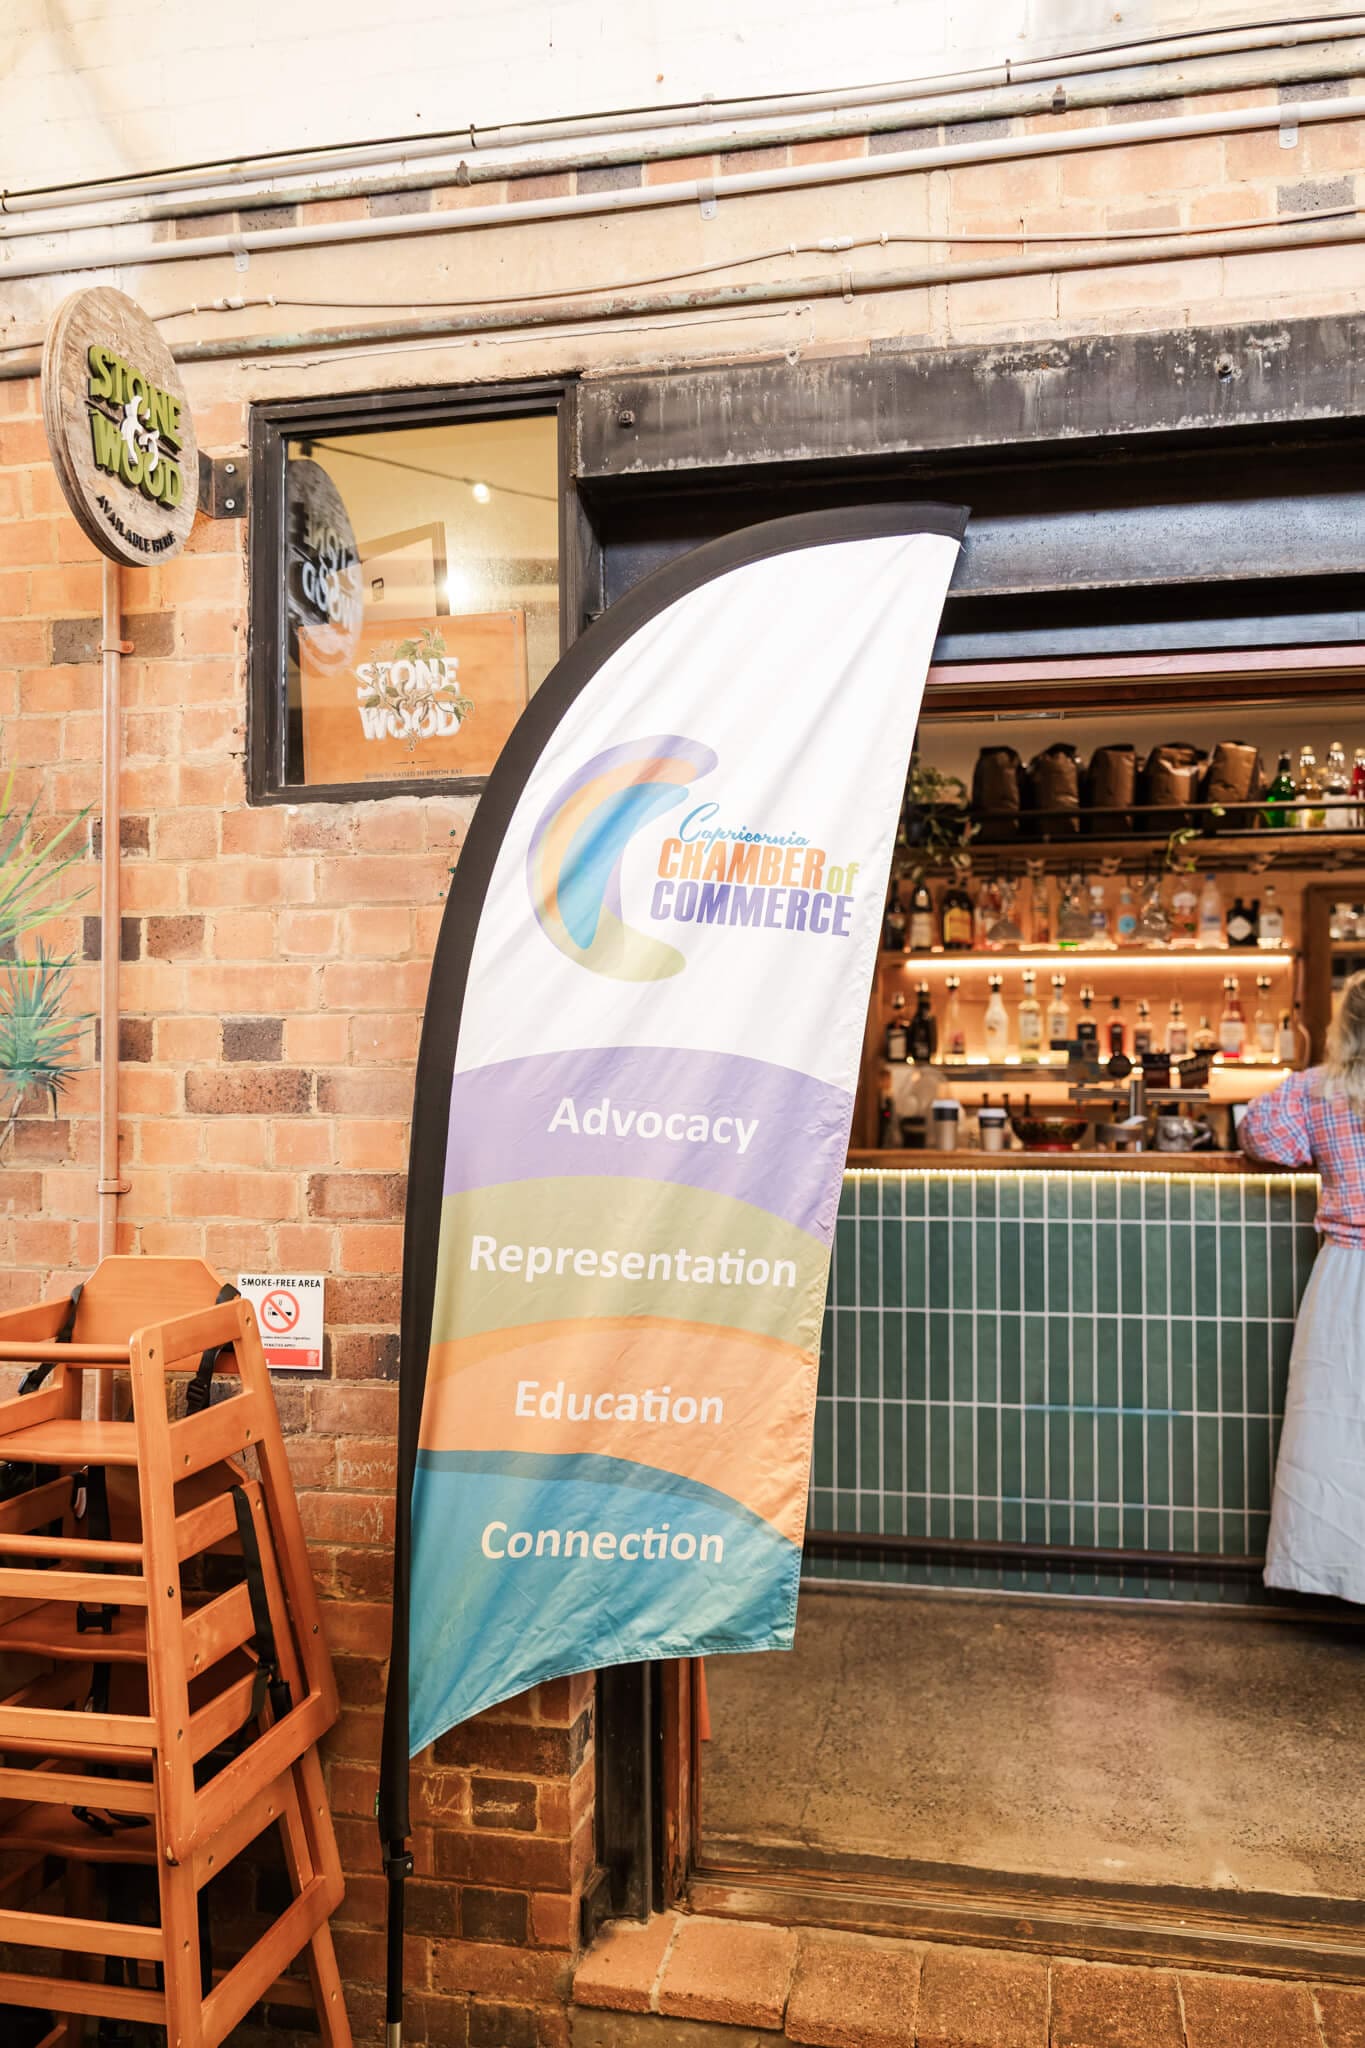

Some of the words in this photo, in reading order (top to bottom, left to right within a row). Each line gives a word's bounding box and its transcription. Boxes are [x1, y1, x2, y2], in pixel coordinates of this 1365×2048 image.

[88, 345, 183, 452] STONE
[88, 408, 184, 510] WOOD
[95, 495, 151, 553] AVAILABLE
[356, 656, 461, 700] STONE
[358, 700, 462, 741] WOOD
[679, 802, 811, 854] Capricornia
[657, 838, 827, 890] CHAMBER
[825, 861, 860, 895] of
[650, 880, 855, 937] COMMERCE
[547, 1097, 759, 1154] Advocacy
[241, 1278, 297, 1287] SMOKE-FREE
[298, 1279, 321, 1288] AREA
[469, 1234, 797, 1288] Representation
[515, 1380, 724, 1425] Education
[481, 1521, 724, 1564] Connection
